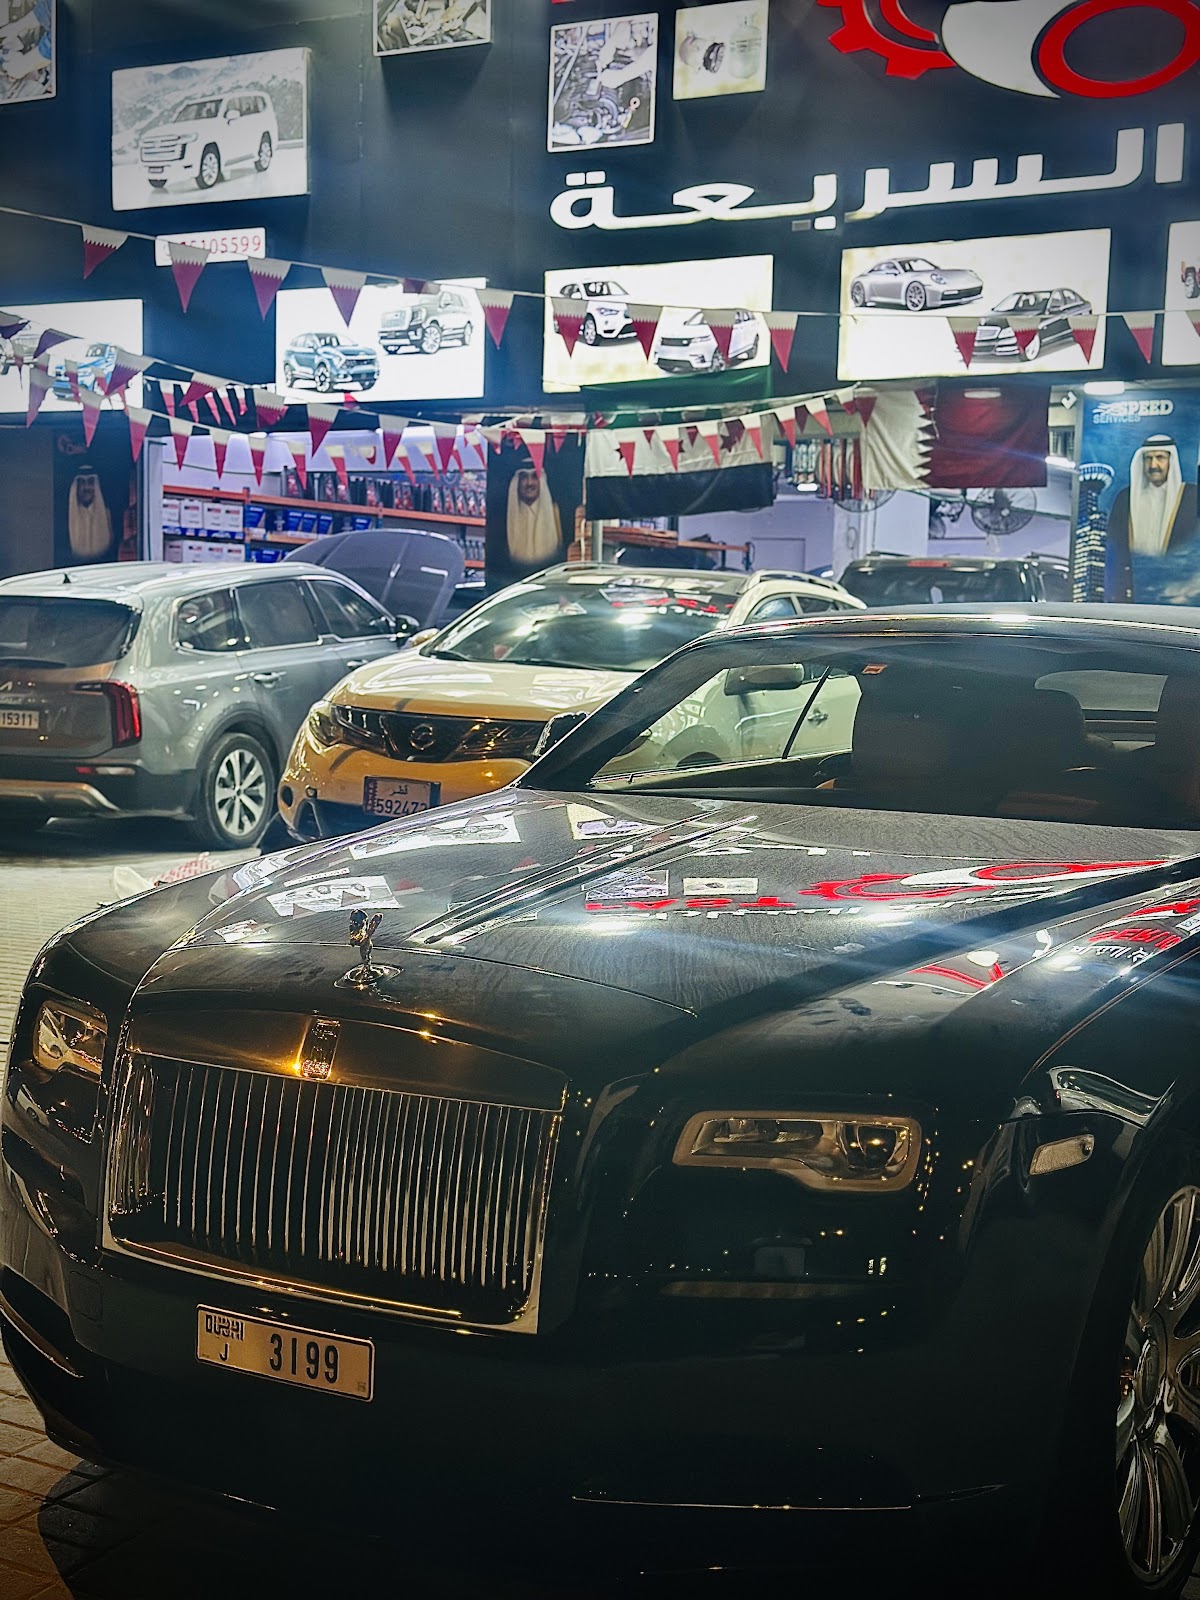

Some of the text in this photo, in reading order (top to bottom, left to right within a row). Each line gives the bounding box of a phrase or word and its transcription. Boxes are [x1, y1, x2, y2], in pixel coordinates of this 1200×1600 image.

[550, 122, 1185, 231] السريعة
[1110, 399, 1174, 416] SPEED
[1092, 413, 1141, 424] SERVICES
[219, 1343, 228, 1361] J
[269, 1333, 338, 1384] 3199
